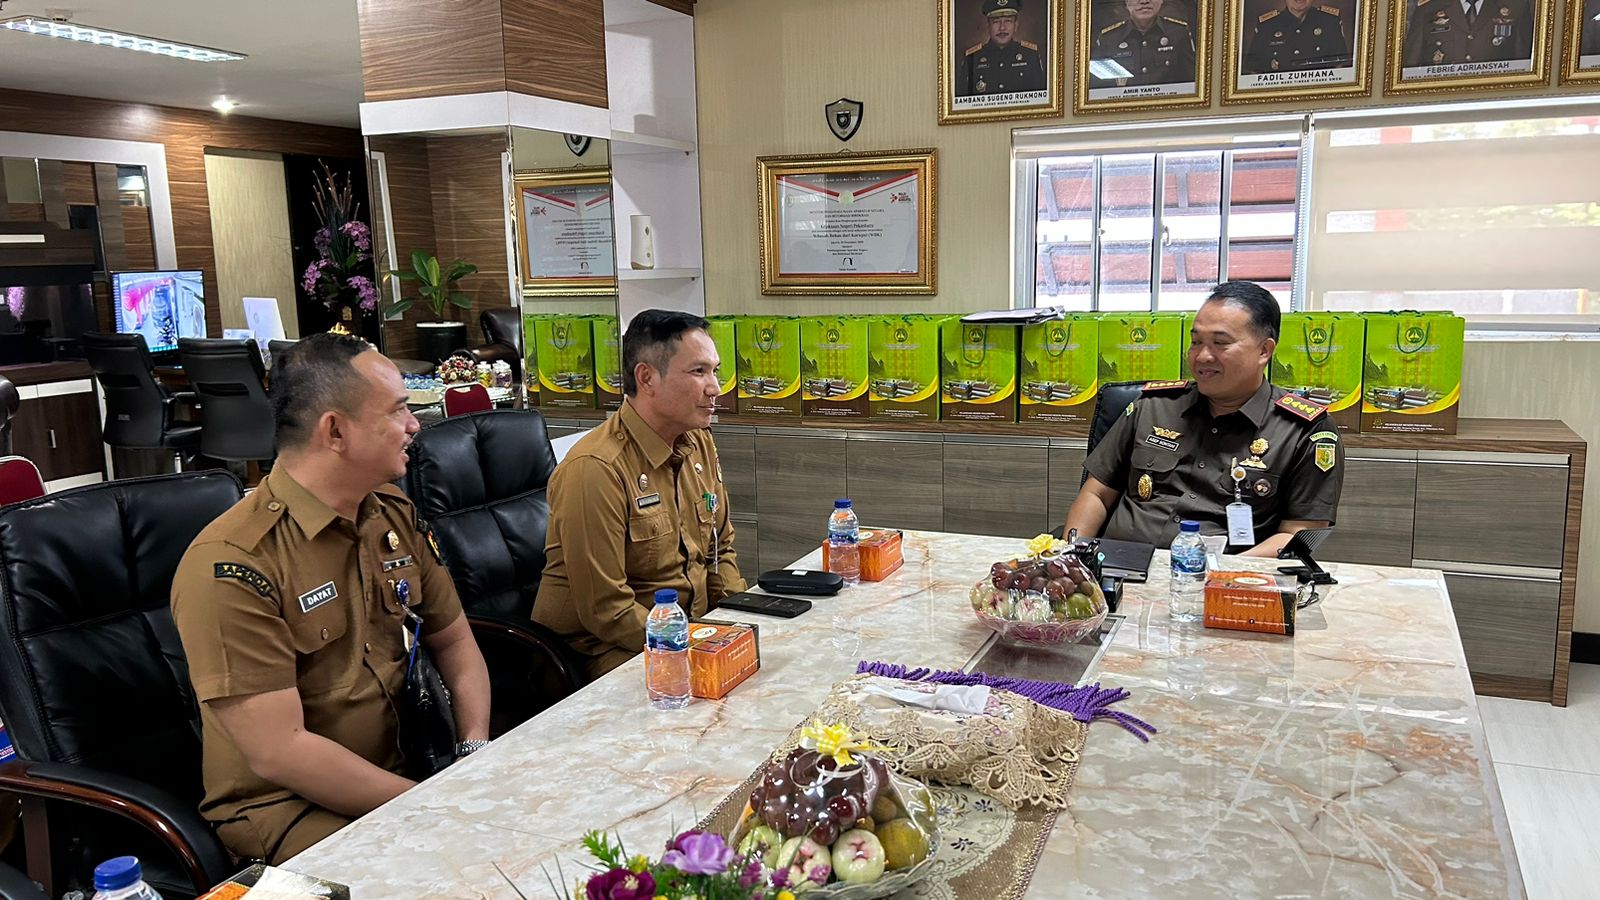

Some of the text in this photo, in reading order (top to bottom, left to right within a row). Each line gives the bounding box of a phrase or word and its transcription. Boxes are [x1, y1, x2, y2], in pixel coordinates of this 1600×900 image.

[1426, 65, 1455, 74] FEBRIE
[1457, 62, 1510, 72] ADRIANSYAH
[1257, 70, 1335, 82] FADIL ZUMHANA
[954, 91, 1048, 105] BAMBANG SUGENG RUKMONO
[306, 587, 332, 606] DAYAT
